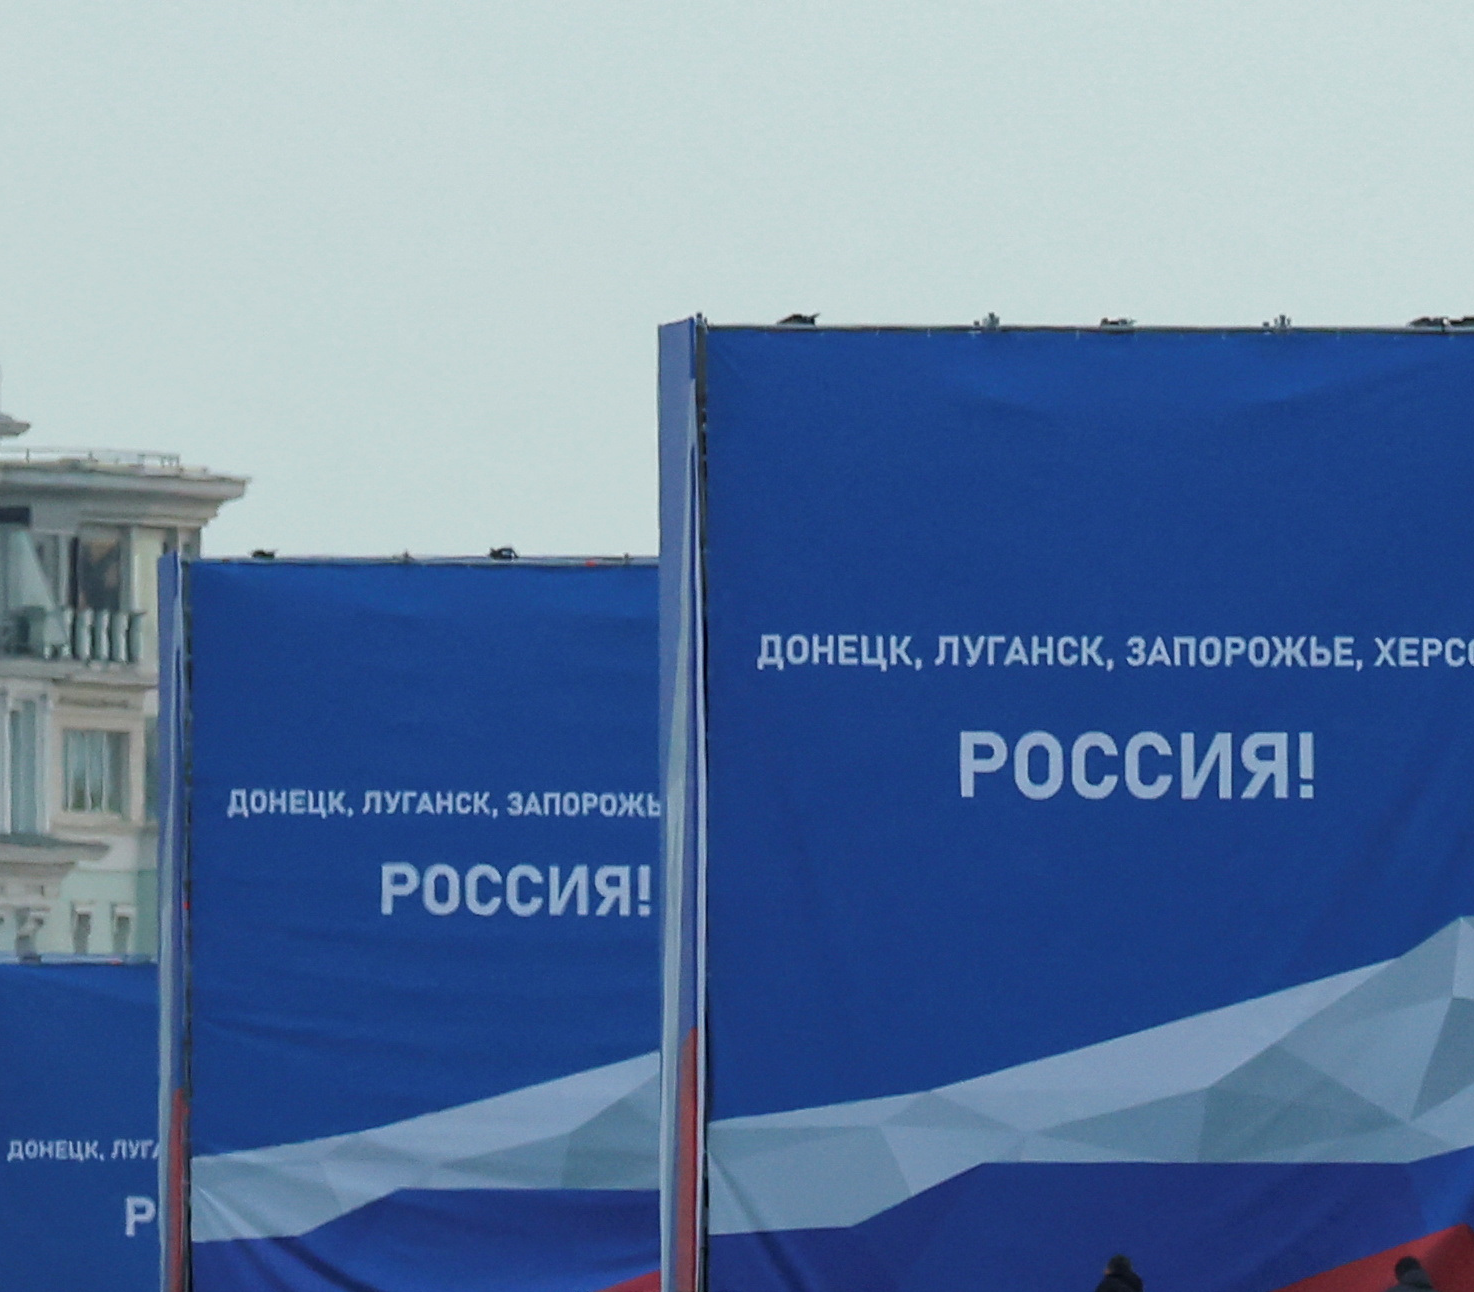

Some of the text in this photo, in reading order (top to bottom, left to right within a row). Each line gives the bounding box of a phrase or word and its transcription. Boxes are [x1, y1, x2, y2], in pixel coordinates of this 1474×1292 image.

[757, 634, 923, 672] ДОНЕЦК,
[934, 635, 1114, 671] ЛУГАНСК,
[1126, 636, 1363, 672] ЗАПОРОЖЬЕ,
[959, 731, 1314, 800] РОССИЯ!
[227, 789, 354, 819] ДОНЕЦК,
[362, 791, 498, 819] ЛУГАНСК,
[381, 863, 651, 917] РОССИЯ!
[6, 1139, 105, 1163] ДОНЕЦК,
